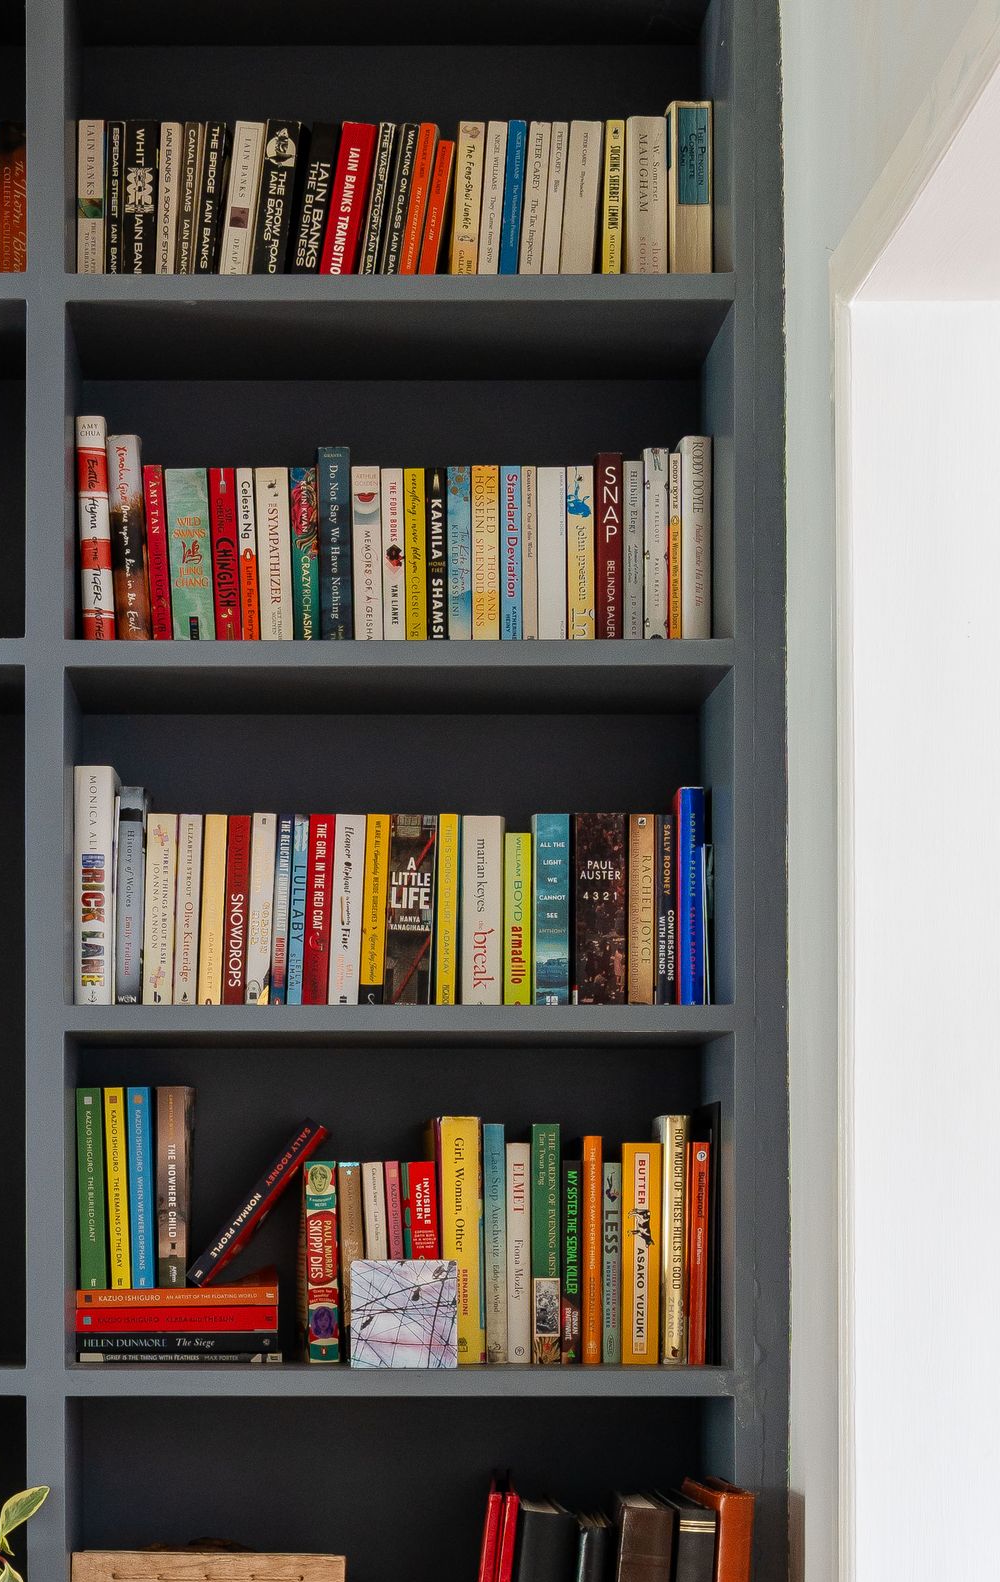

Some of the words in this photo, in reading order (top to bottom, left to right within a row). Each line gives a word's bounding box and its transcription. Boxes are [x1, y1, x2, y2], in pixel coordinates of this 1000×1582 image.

[210, 126, 220, 149] THE
[534, 132, 543, 159] PETER
[206, 151, 217, 193] BRIDGE
[346, 147, 361, 171] IAIN
[609, 145, 620, 172] SUCKING
[267, 170, 279, 195] IAIN
[277, 171, 287, 195] THE
[532, 161, 542, 191] CAREY
[608, 174, 620, 202] SHERBET
[340, 175, 358, 213] BANKS
[530, 198, 539, 214] The
[204, 200, 213, 223] IAIN
[264, 198, 275, 241] BANKS
[270, 199, 283, 236] CROW
[529, 215, 538, 228] Tax
[608, 205, 619, 230] LEMONS
[200, 227, 210, 269] BANKS
[267, 238, 279, 273] ROAD
[329, 216, 349, 275] TRANSITIO
[526, 229, 536, 266] Inspector
[329, 464, 339, 479] Do
[148, 480, 158, 506] AMY
[241, 481, 251, 520] Celeste
[329, 482, 339, 501] Not
[506, 473, 518, 533] Standard
[150, 510, 160, 534] TAN
[328, 504, 339, 524] Say
[241, 523, 253, 539] Ng
[330, 527, 339, 543] We
[431, 498, 442, 560] KAMILA
[266, 508, 282, 605] SYMPATHIZER
[331, 546, 340, 574] Have
[506, 536, 519, 598] Deviation
[607, 560, 615, 602] BELINDA
[331, 577, 341, 619] Nothing
[607, 606, 615, 638] BAUER
[88, 775, 98, 826] MONICA
[88, 832, 98, 850] ALI
[316, 823, 327, 839] THE
[663, 824, 671, 852] SALLY
[315, 840, 326, 859] GIRL
[407, 856, 417, 871] A
[476, 838, 488, 879] marian
[314, 862, 325, 871] IN
[391, 871, 431, 887] LITTLE
[580, 870, 621, 881] AUSTER
[587, 860, 614, 870] PAUL
[663, 855, 671, 895] ROONEY
[81, 853, 105, 923] BRICK
[314, 874, 325, 889] THE
[291, 864, 306, 943] LULLABY
[313, 891, 324, 907] RED
[390, 887, 430, 910] LIFE
[474, 881, 487, 913] keyes
[312, 910, 323, 930] COAT
[658, 916, 666, 938] WITH
[228, 893, 244, 987] SNOWDROPS
[667, 910, 675, 981] CONVERSATIONS
[81, 930, 105, 987] LANE
[658, 940, 667, 975] FRIENDS
[85, 1110, 93, 1134] KAZUO
[86, 1136, 94, 1173] ISHIGURO
[167, 1143, 176, 1162] THE
[453, 1137, 465, 1165] Girl,
[167, 1164, 177, 1208] NOWHERE
[454, 1168, 465, 1216] Woman,
[513, 1163, 525, 1214] ELMET
[637, 1159, 647, 1205] BUTTER
[87, 1192, 95, 1216] BURIED
[231, 1192, 263, 1227] NORMAL
[415, 1183, 423, 1220] WOMEN
[423, 1177, 431, 1224] INVISIBLE
[88, 1218, 96, 1243] GIANT
[168, 1211, 177, 1237] CHILD
[309, 1219, 323, 1254] SKIPPY
[323, 1220, 332, 1243] PAUL
[455, 1218, 465, 1252] Other
[605, 1210, 618, 1255] LESS
[209, 1227, 236, 1259] PEOPLE
[310, 1256, 323, 1279] DIES
[324, 1245, 333, 1279] MURRAY
[636, 1247, 646, 1289] ASAKO
[636, 1294, 646, 1338] YUZUKI
[83, 1338, 114, 1348] HELEN
[116, 1339, 168, 1348] DUNMORE
[175, 1338, 193, 1347] The
[194, 1338, 215, 1348] Siege
